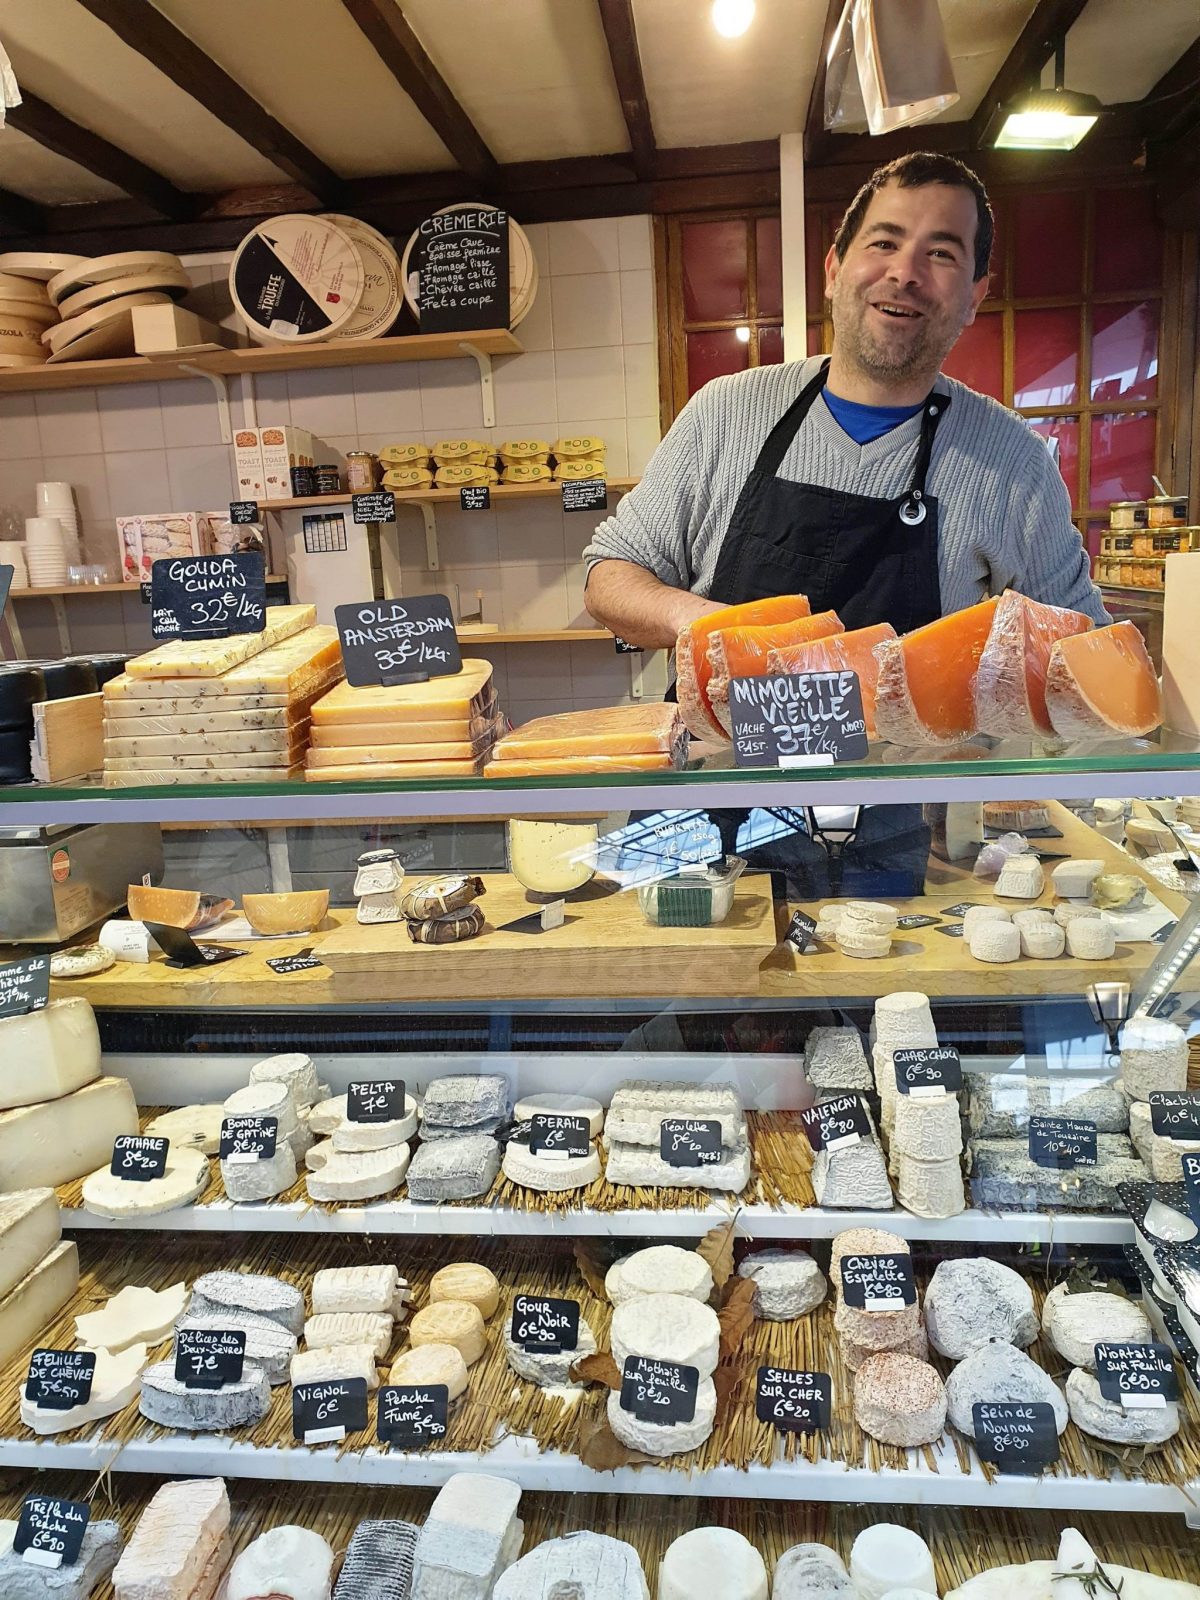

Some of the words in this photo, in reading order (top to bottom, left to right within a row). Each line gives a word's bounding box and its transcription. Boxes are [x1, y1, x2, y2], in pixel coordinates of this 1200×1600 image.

[425, 263, 467, 273] Fromage
[424, 274, 465, 284] Fromage
[261, 273, 282, 311] TRUFFE
[460, 295, 494, 309] coupe
[0, 329, 24, 337] ZOLA
[169, 558, 238, 583] GOUDA
[358, 605, 408, 625] OLD
[344, 617, 454, 647] AMSTERDAM
[732, 671, 855, 707] MIMOLETTE
[760, 696, 850, 725] VIEILLE
[735, 723, 766, 736] VACHE
[841, 719, 865, 735] NORD
[28, 960, 46, 971] de
[351, 1082, 396, 1096] PELTA
[361, 1095, 388, 1114] 7€
[802, 1095, 858, 1125] VALENCAY
[227, 1118, 264, 1129] BONDE
[536, 1116, 586, 1130] PERAIL
[1031, 1118, 1063, 1130] Sainte
[221, 1129, 234, 1139] DE
[544, 1130, 566, 1147] 6€
[114, 1137, 165, 1151] CATHARE
[1043, 1140, 1081, 1156] 10€40
[122, 1150, 158, 1168] 8€20
[843, 1270, 906, 1287] Espelette
[179, 1331, 217, 1344] Délices
[220, 1331, 239, 1344] des
[29, 1367, 46, 1379] DE
[191, 1355, 218, 1375] 7€
[645, 1372, 689, 1393] feuille
[765, 1369, 814, 1384] SELLES
[297, 1385, 350, 1402] VIGNOL
[759, 1384, 786, 1398] SUR
[788, 1387, 824, 1401] CHER
[316, 1398, 340, 1420] 6€
[980, 1407, 1013, 1419] Sein
[1017, 1407, 1037, 1419] de
[982, 1420, 1034, 1434] Nounou
[64, 1506, 83, 1523] du
[29, 1514, 69, 1533] Perche
